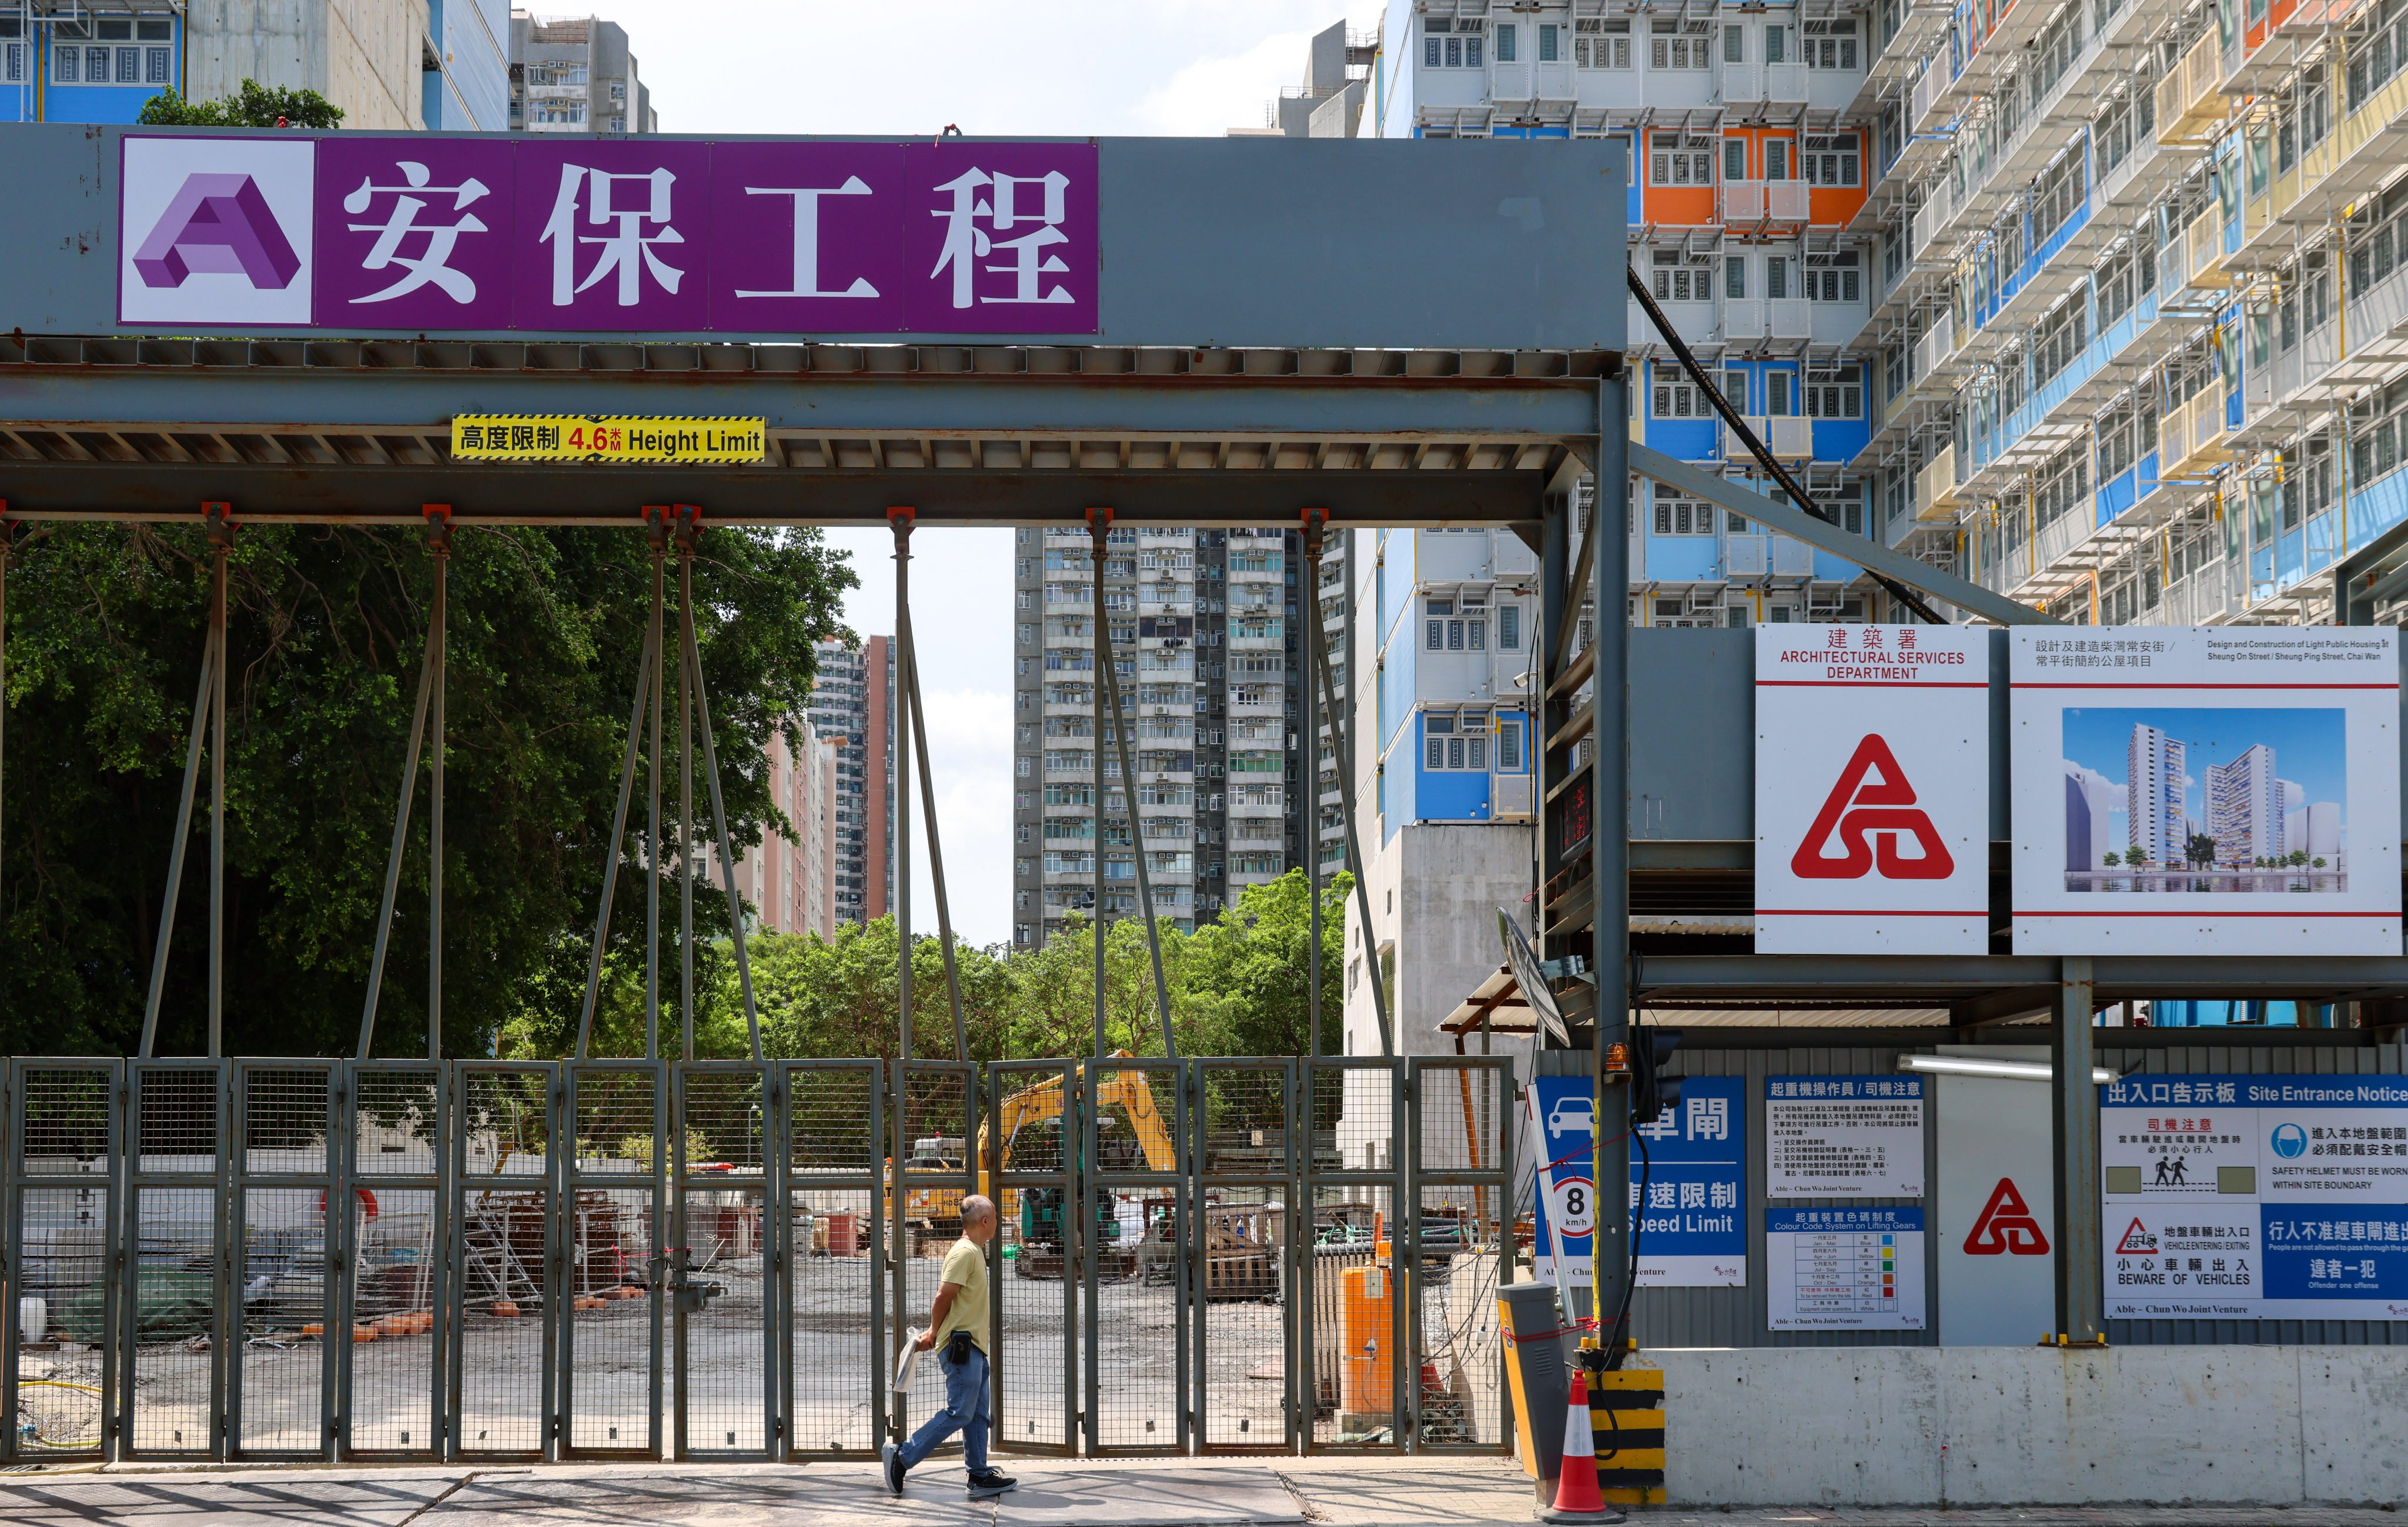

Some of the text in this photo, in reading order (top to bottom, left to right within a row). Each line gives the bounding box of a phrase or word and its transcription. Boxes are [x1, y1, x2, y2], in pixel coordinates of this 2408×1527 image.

[343, 161, 1075, 309] 安保工程
[460, 426, 560, 451] 高度限制
[568, 427, 608, 451] 4.6
[629, 430, 760, 457] Height Limit
[1828, 628, 1918, 649] 建築署
[2036, 640, 2164, 652] 設計及建造柴灣常安街
[2208, 641, 2232, 649] Design
[2306, 641, 2324, 649] Light
[2350, 641, 2380, 649] Housing
[1781, 651, 1964, 664] ARCHITECTURAL SERVICES
[2036, 655, 2150, 667] 常平街簡約公屋項目
[2208, 653, 2235, 661] Sheung
[2276, 653, 2302, 661] Sheung
[2305, 653, 2320, 661] Ping
[1828, 667, 1918, 679] DEPARTMENT
[1771, 1082, 1919, 1096] 起重機操作員 / 司機注意
[2249, 1086, 2408, 1101] Site Entrance Notice
[2148, 1119, 2212, 1130] 司機注意
[2312, 1127, 2406, 1139] 進入本地盤範圍
[2313, 1144, 2406, 1156] 必須配戴安全帽
[1567, 1188, 1584, 1215] 8
[1795, 1212, 1895, 1223] 起重裝置色碼制度
[1686, 1215, 1733, 1233] Limit
[1825, 1223, 1853, 1231] System
[1868, 1223, 1890, 1231] Lifting
[2165, 1227, 2249, 1237] 地盤車輛出入口
[2164, 1241, 2250, 1250] VEHICLE ENTERING EXITING
[2269, 1244, 2291, 1252] People
[2363, 1244, 2390, 1253] through
[2118, 1258, 2249, 1271] 小心車輛出入
[2310, 1259, 2376, 1278] 違者一犯
[2119, 1274, 2249, 1285] BEWARE OF VEHICLES
